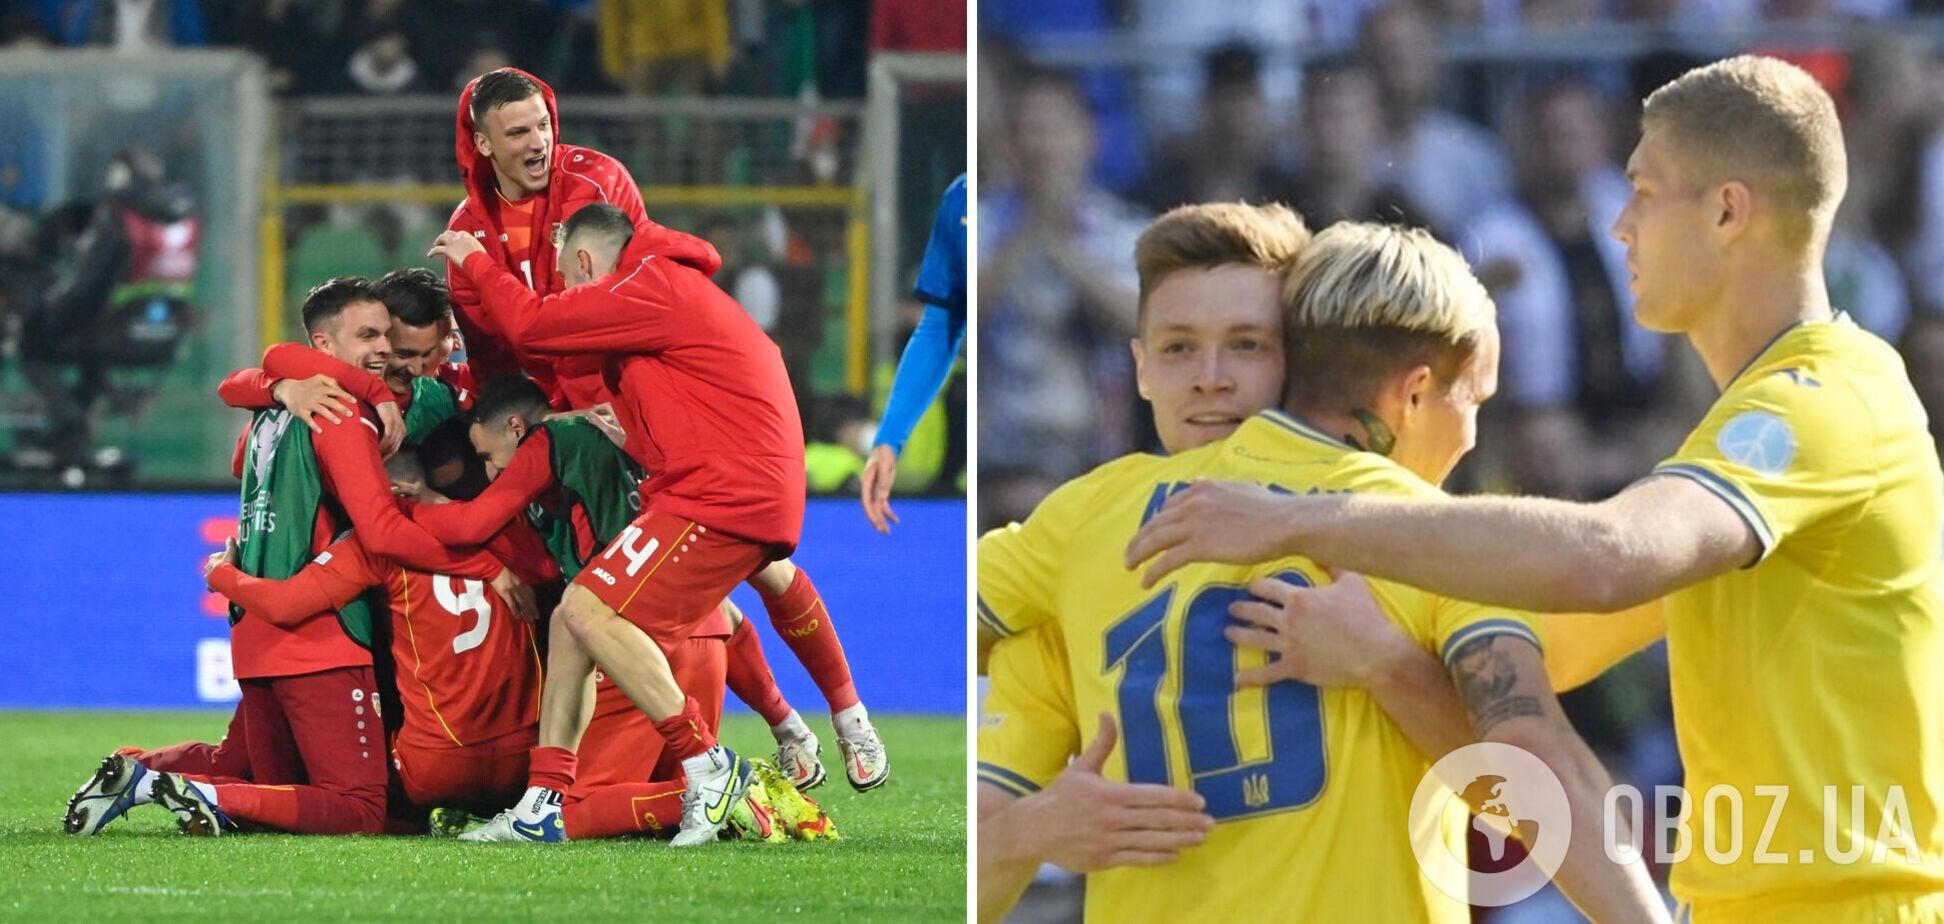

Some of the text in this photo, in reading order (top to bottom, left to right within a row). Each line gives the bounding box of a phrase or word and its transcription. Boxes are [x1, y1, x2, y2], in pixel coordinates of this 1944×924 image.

[592, 567, 616, 585] JAKO
[603, 525, 660, 577] 14
[433, 574, 491, 654] 9
[1101, 567, 1329, 824] 10
